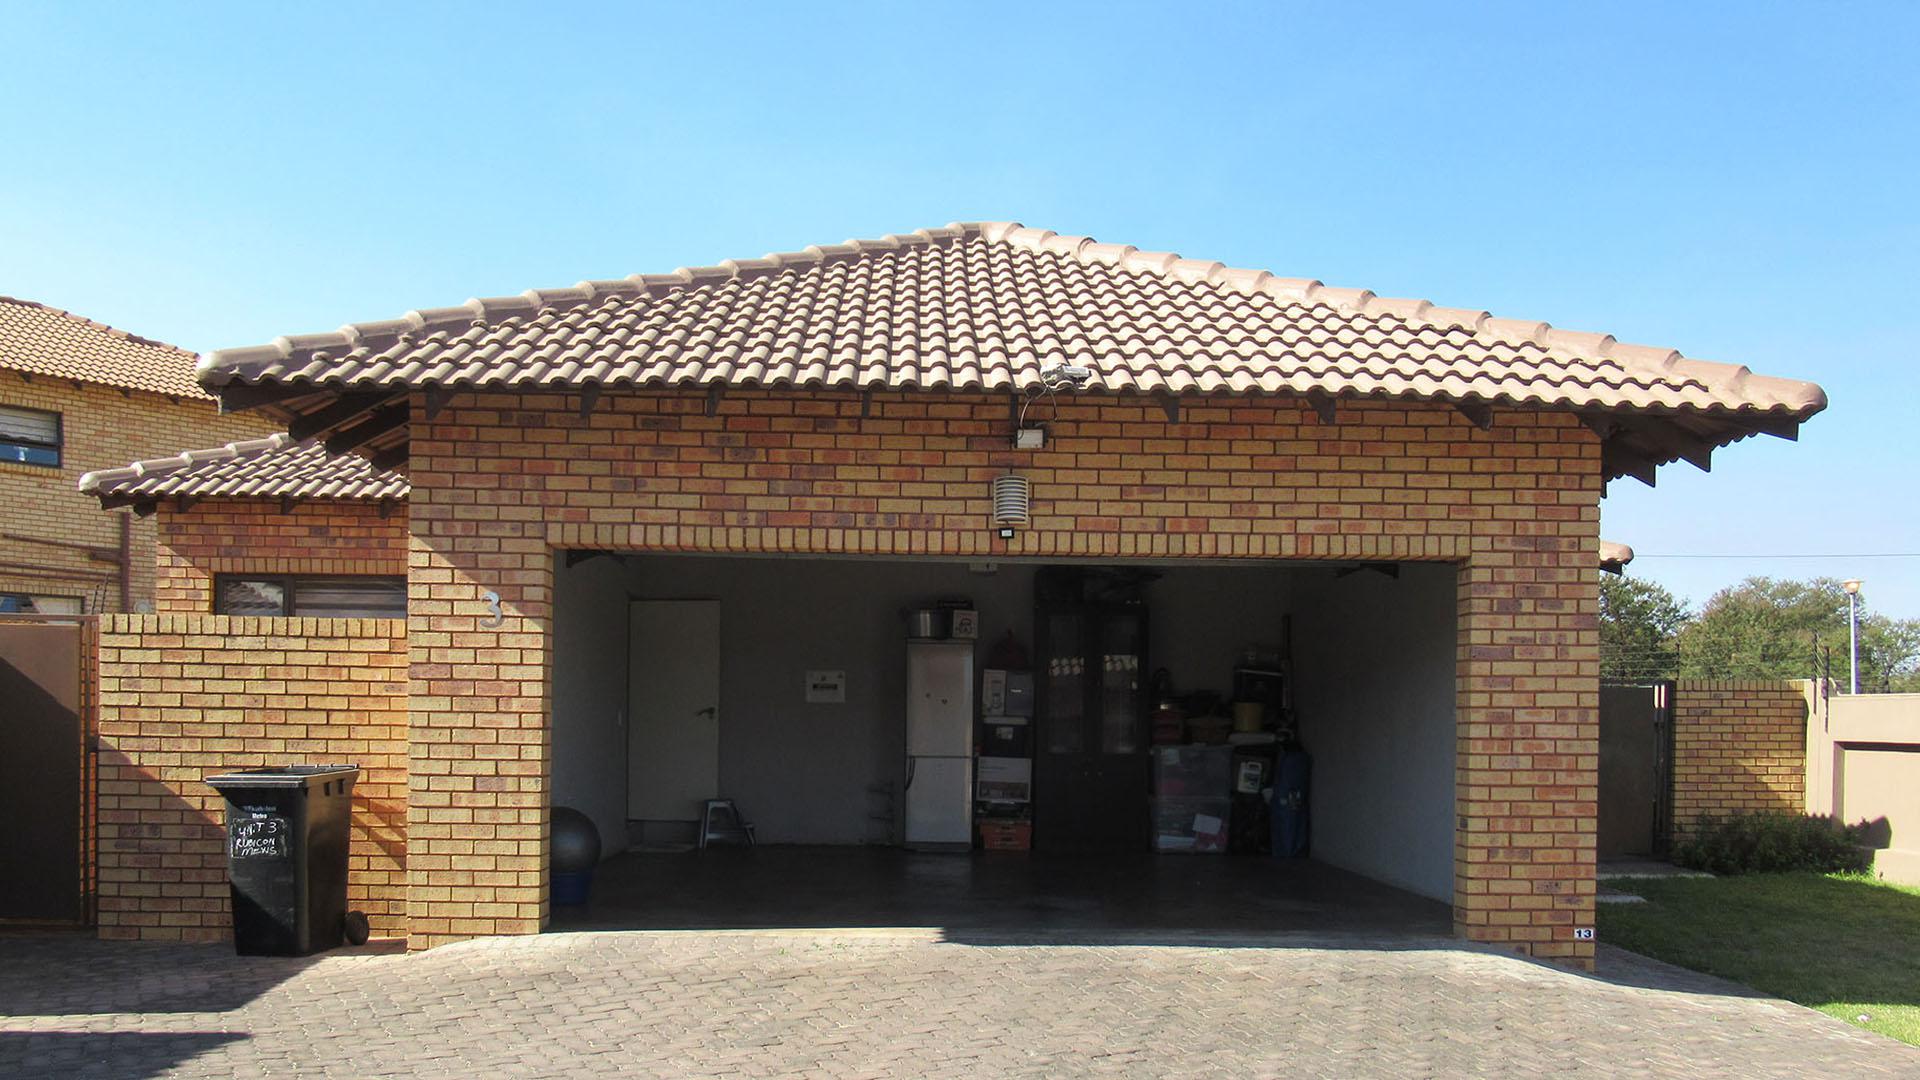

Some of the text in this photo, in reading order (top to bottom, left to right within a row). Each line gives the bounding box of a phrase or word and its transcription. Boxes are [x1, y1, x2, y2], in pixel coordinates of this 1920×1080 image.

[480, 591, 502, 628] 3
[268, 821, 278, 834] 3
[236, 838, 276, 849] RUBICON
[1576, 929, 1592, 938] 13
